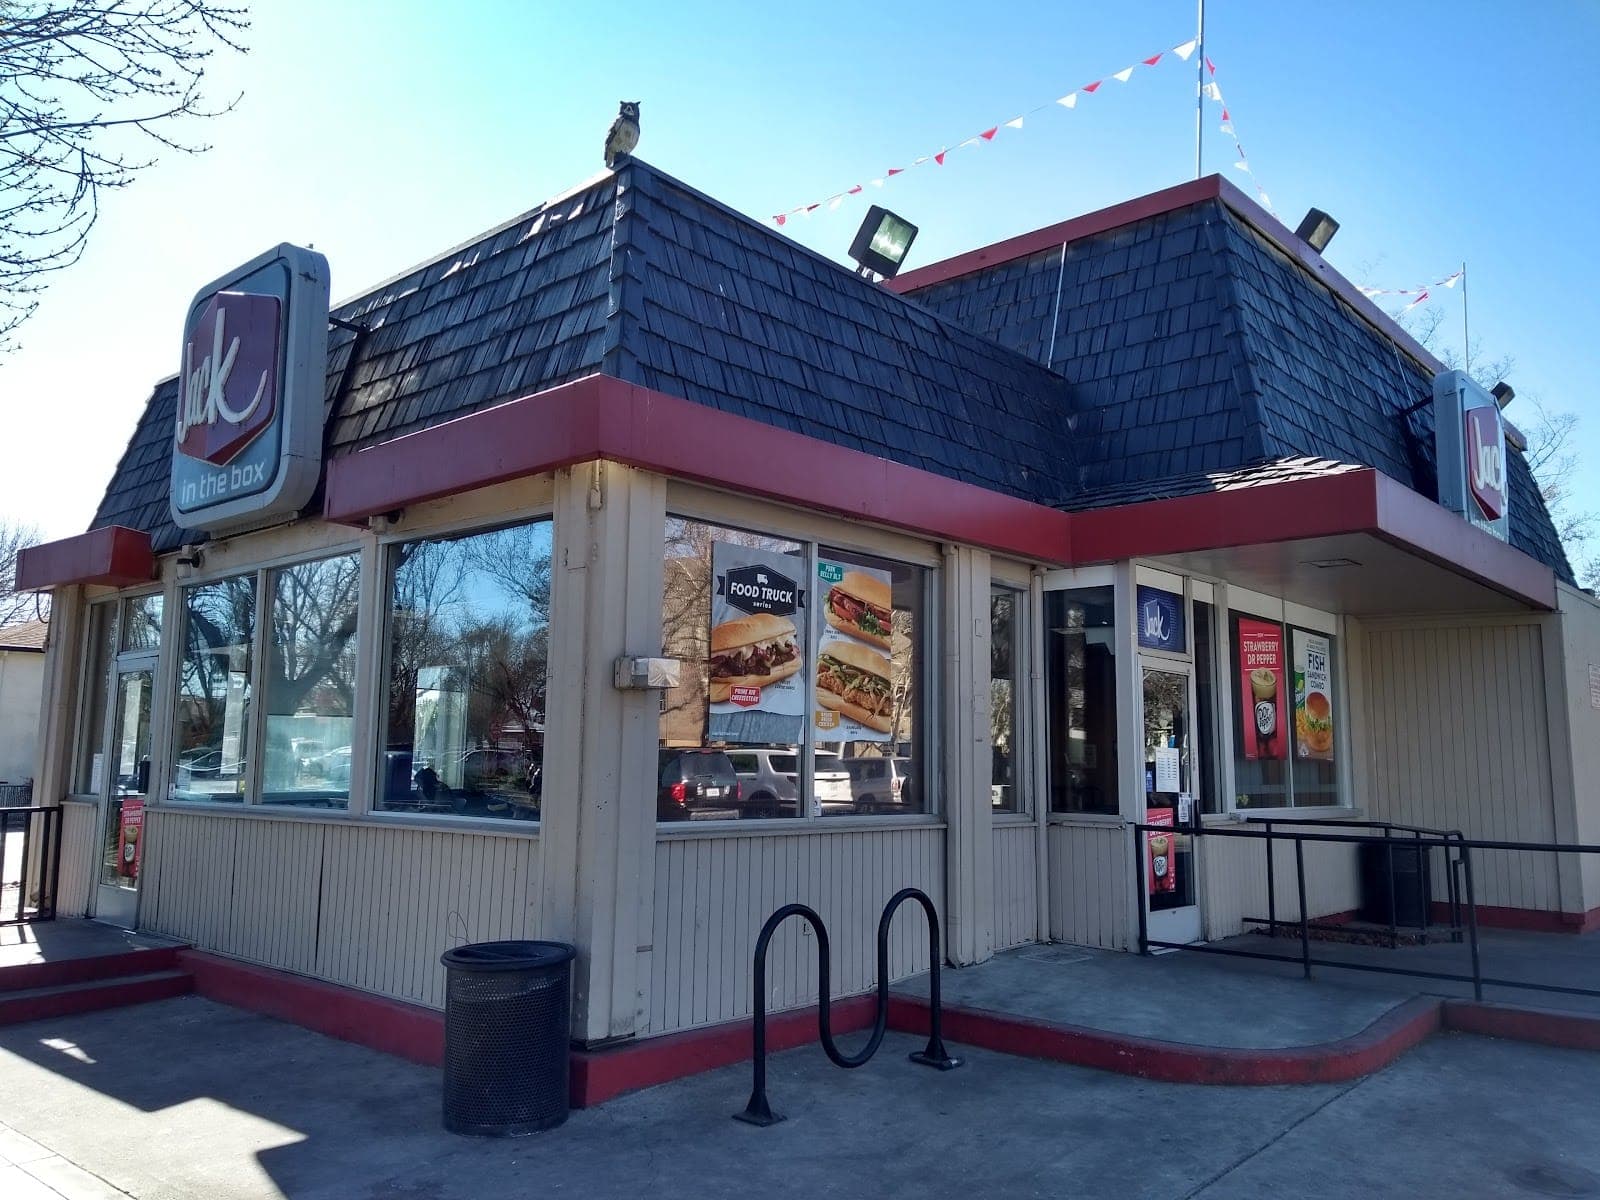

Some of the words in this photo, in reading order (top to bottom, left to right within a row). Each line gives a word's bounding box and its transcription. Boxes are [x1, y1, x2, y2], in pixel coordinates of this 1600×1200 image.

[178, 307, 268, 443] Jack
[181, 480, 196, 504] in
[200, 473, 227, 498] the
[231, 462, 264, 490] box
[730, 582, 760, 598] FOOD
[761, 587, 793, 603] TRUCK
[752, 601, 772, 609] series
[1145, 604, 1170, 640] Jack
[1243, 641, 1279, 652] STRAWBERRY
[1247, 654, 1256, 665] DR
[1256, 653, 1277, 665] PEPPER
[1308, 653, 1325, 671] FISH
